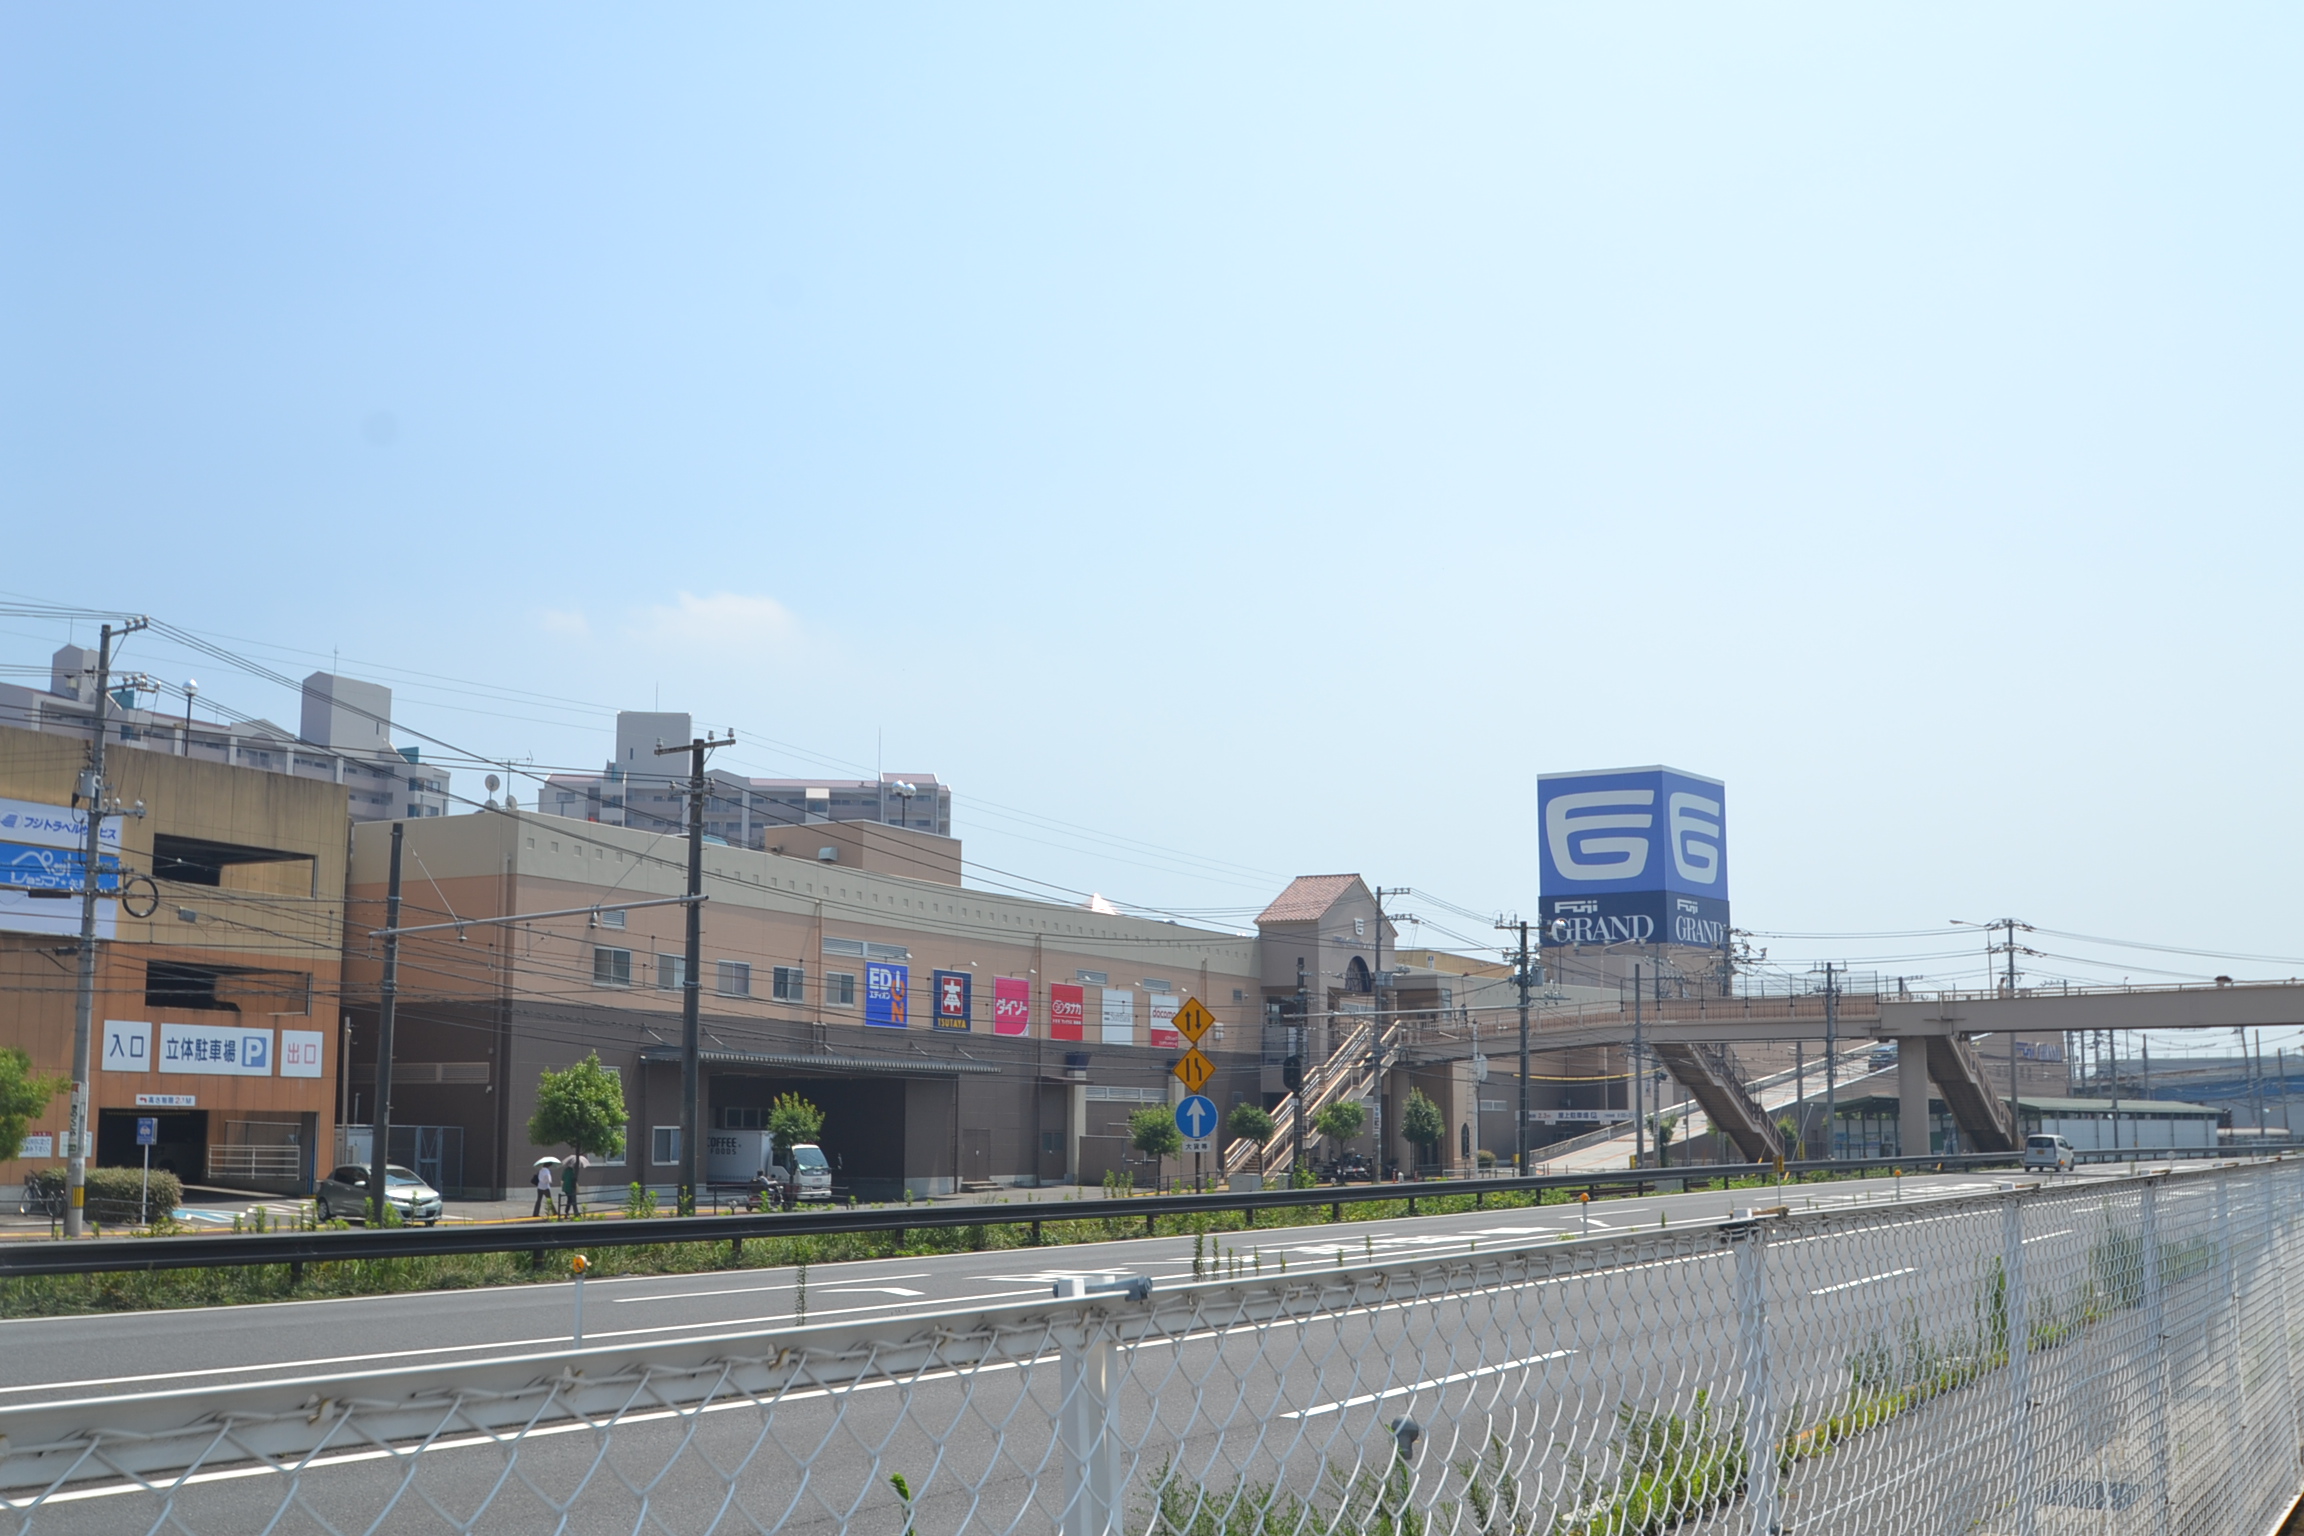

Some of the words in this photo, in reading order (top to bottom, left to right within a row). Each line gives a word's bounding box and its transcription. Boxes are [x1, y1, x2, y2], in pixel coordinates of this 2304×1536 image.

[24, 816, 117, 840] フジトラベルサビス
[1554, 900, 1598, 914] Fuji
[1551, 915, 1655, 943] GRAND
[1675, 915, 1724, 944] GRAND
[996, 998, 1028, 1016] ダイソー
[937, 1017, 967, 1029] TSUTAYA
[109, 1033, 145, 1058] 入口
[165, 1036, 237, 1063] 立体駐車場
[287, 1042, 317, 1065] 出口
